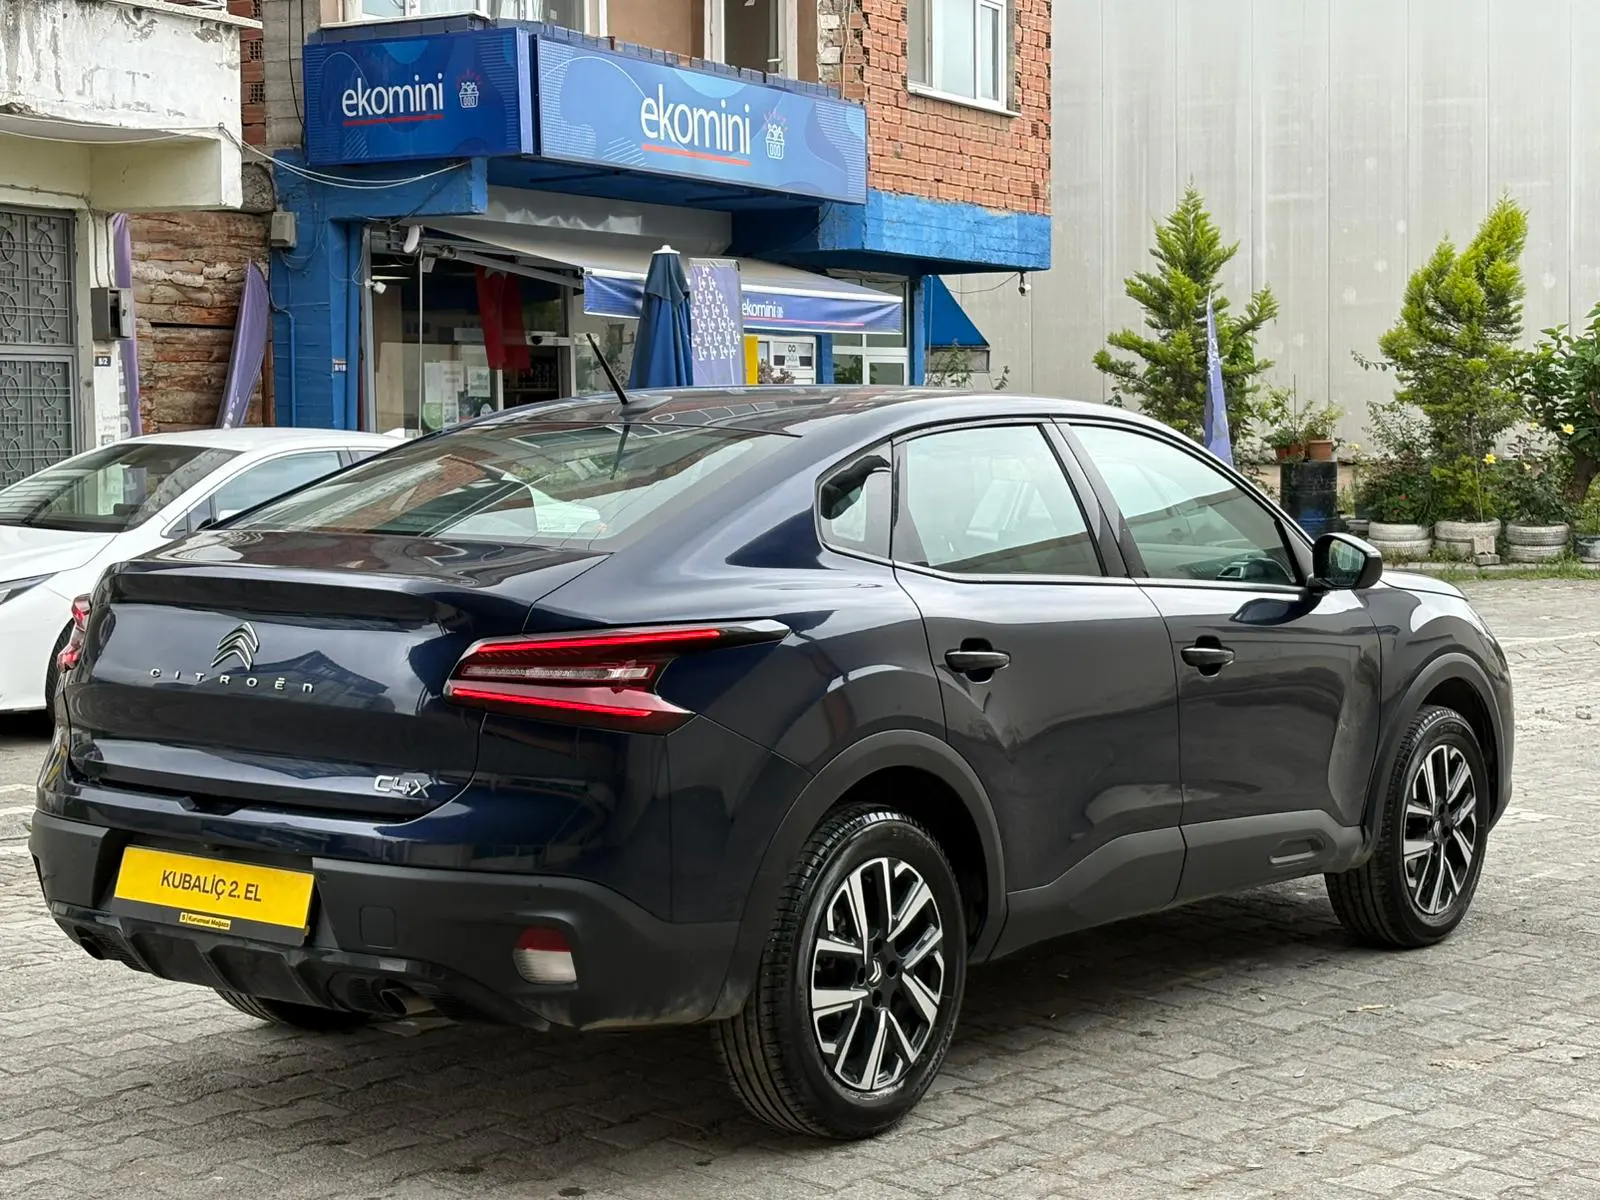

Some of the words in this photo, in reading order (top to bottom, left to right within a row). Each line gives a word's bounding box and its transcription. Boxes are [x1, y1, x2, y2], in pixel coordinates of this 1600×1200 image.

[342, 73, 443, 117] ekomini
[640, 83, 750, 155] ekomini
[742, 298, 776, 318] ekomini
[161, 869, 226, 900] KUBALİÇ
[228, 880, 241, 899] 2.
[244, 883, 262, 902] EL
